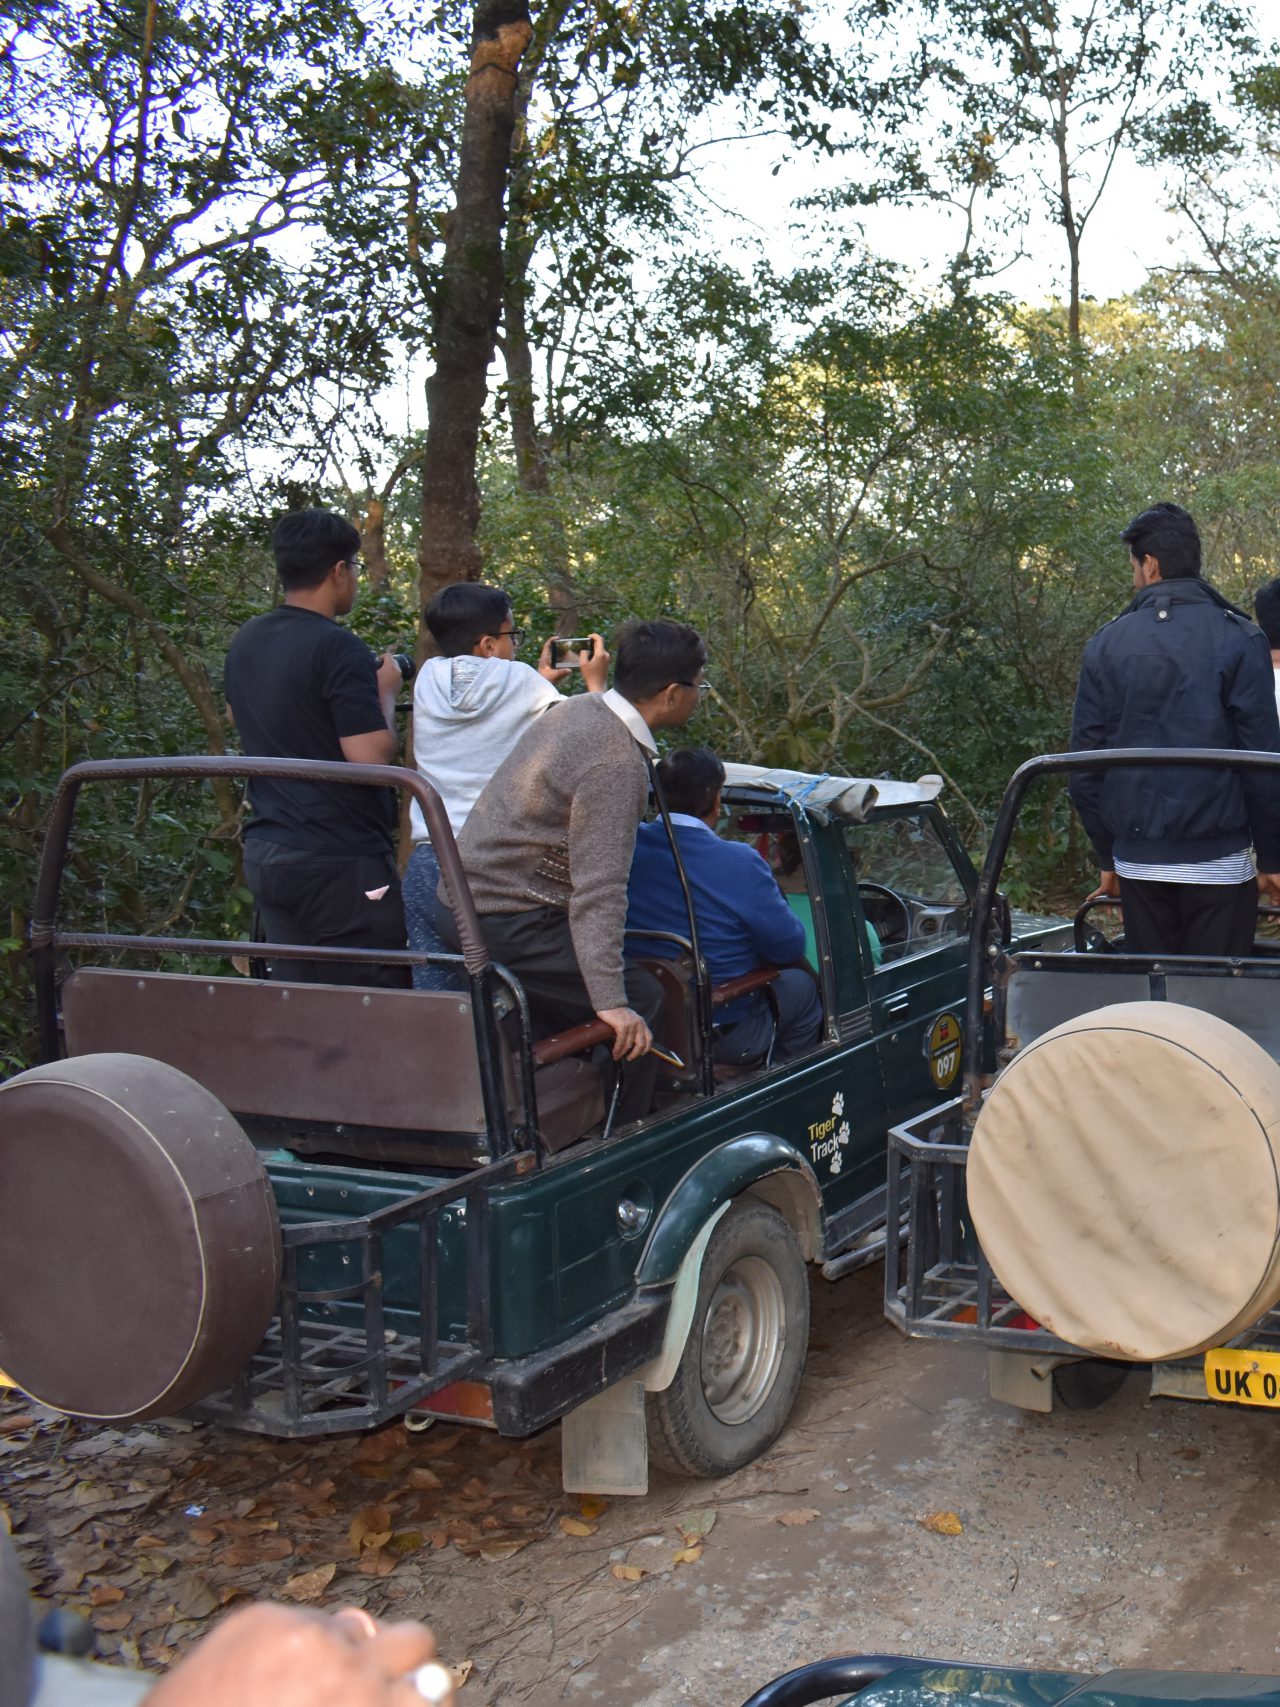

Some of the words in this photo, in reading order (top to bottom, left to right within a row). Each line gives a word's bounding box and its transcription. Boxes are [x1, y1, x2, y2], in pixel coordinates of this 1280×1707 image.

[937, 1052, 955, 1078] 097
[808, 1116, 837, 1140] Tiger
[811, 1135, 840, 1163] Track
[1215, 1369, 1252, 1398] UK
